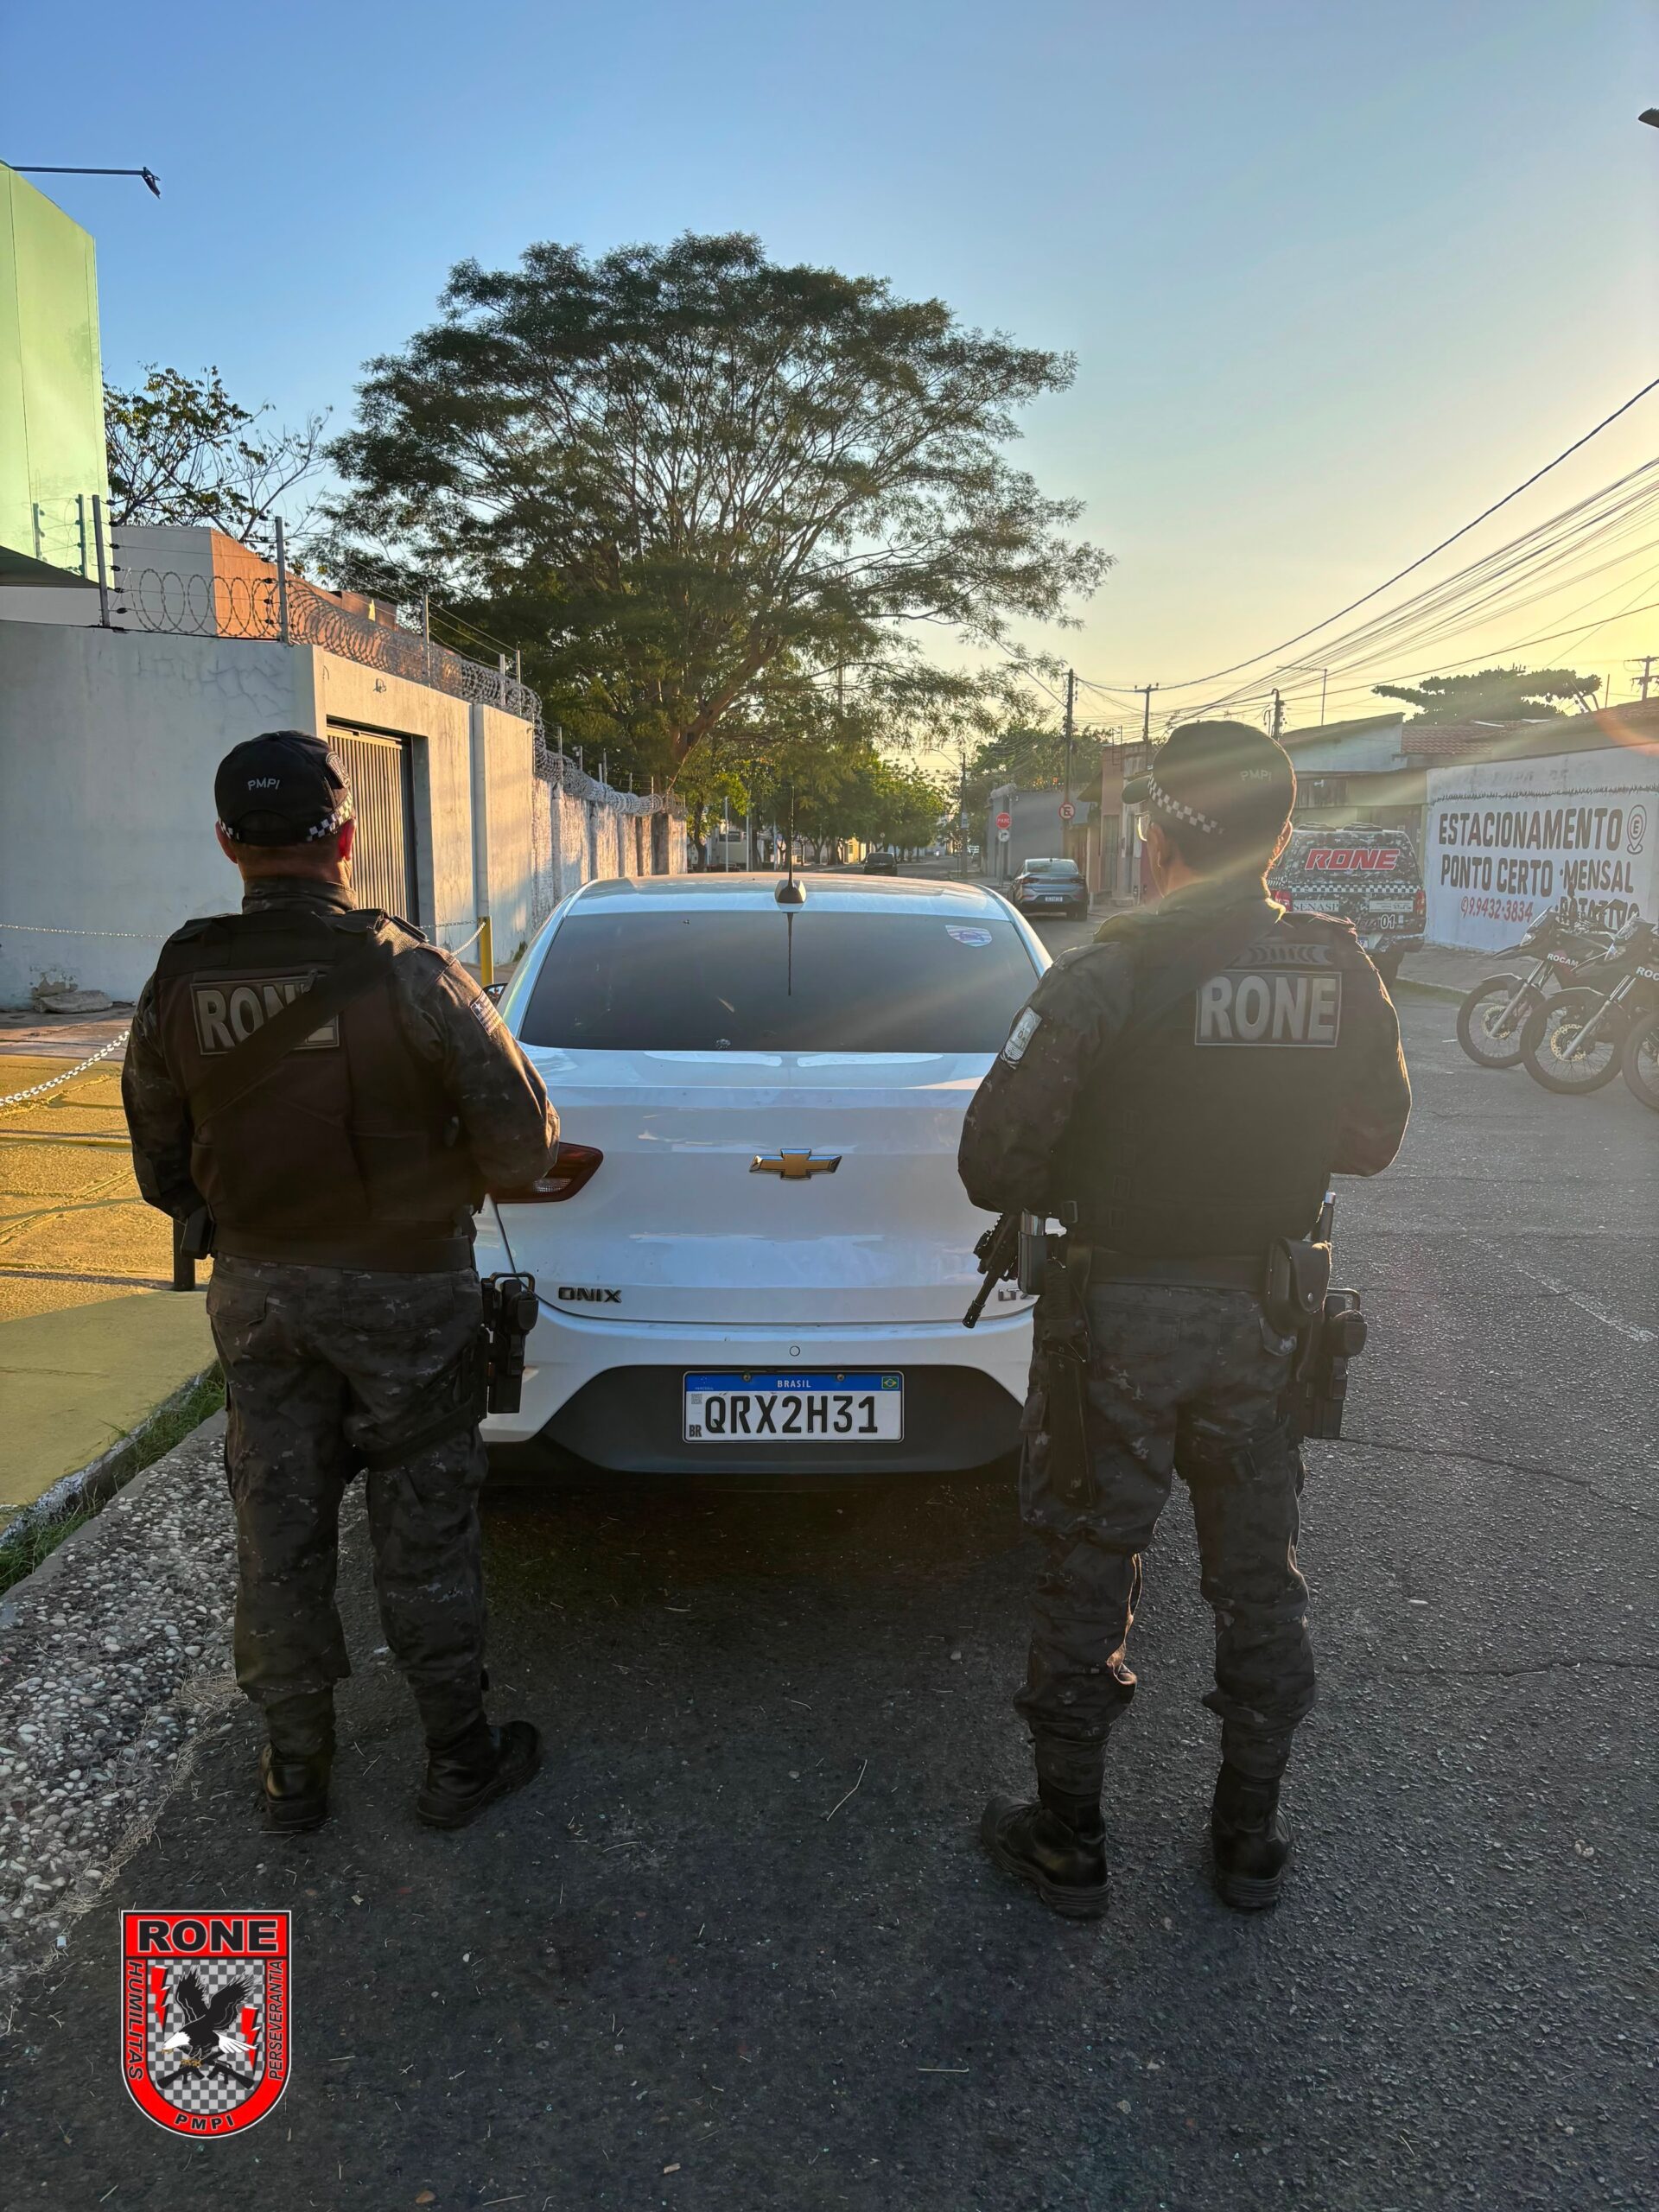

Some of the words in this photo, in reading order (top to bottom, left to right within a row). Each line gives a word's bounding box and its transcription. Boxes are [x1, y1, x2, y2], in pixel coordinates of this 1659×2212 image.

[1240, 769, 1272, 781] PMPI
[248, 779, 281, 791] PMPI
[1439, 807, 1624, 851] ESTACIONAMENTO
[1305, 849, 1400, 870] RONE
[1440, 854, 1493, 892] PONTO
[1497, 857, 1554, 898] CERTO
[1294, 903, 1339, 912] SENASP
[1381, 914, 1395, 929] 01
[1547, 953, 1579, 967] ROCAM
[1200, 975, 1337, 1040] RONE
[196, 984, 334, 1049] RON
[558, 1287, 622, 1303] ONIX
[777, 1380, 811, 1389] BRASIL
[705, 1395, 878, 1433] QRX2H31
[689, 1424, 702, 1438] BR
